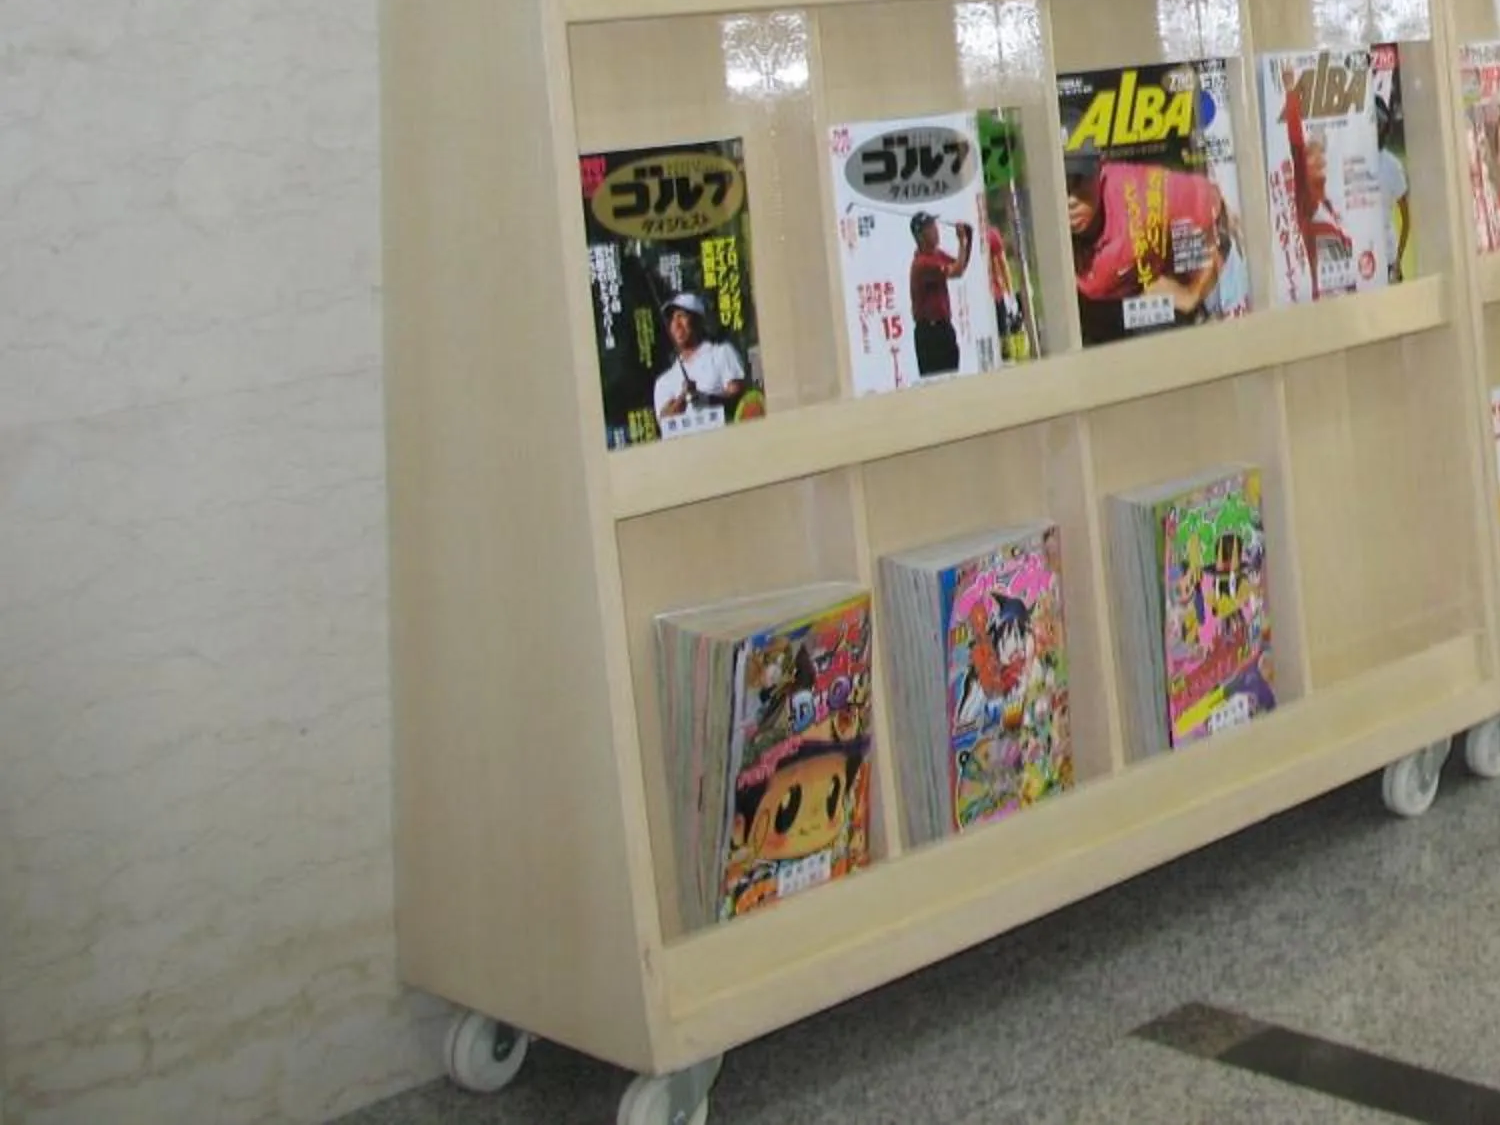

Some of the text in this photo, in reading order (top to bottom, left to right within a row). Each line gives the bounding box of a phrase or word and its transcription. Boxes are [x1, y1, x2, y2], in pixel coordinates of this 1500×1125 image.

[1066, 69, 1194, 152] ALBA
[861, 134, 970, 186] ゴルフ
[609, 164, 734, 220] ゴルフ
